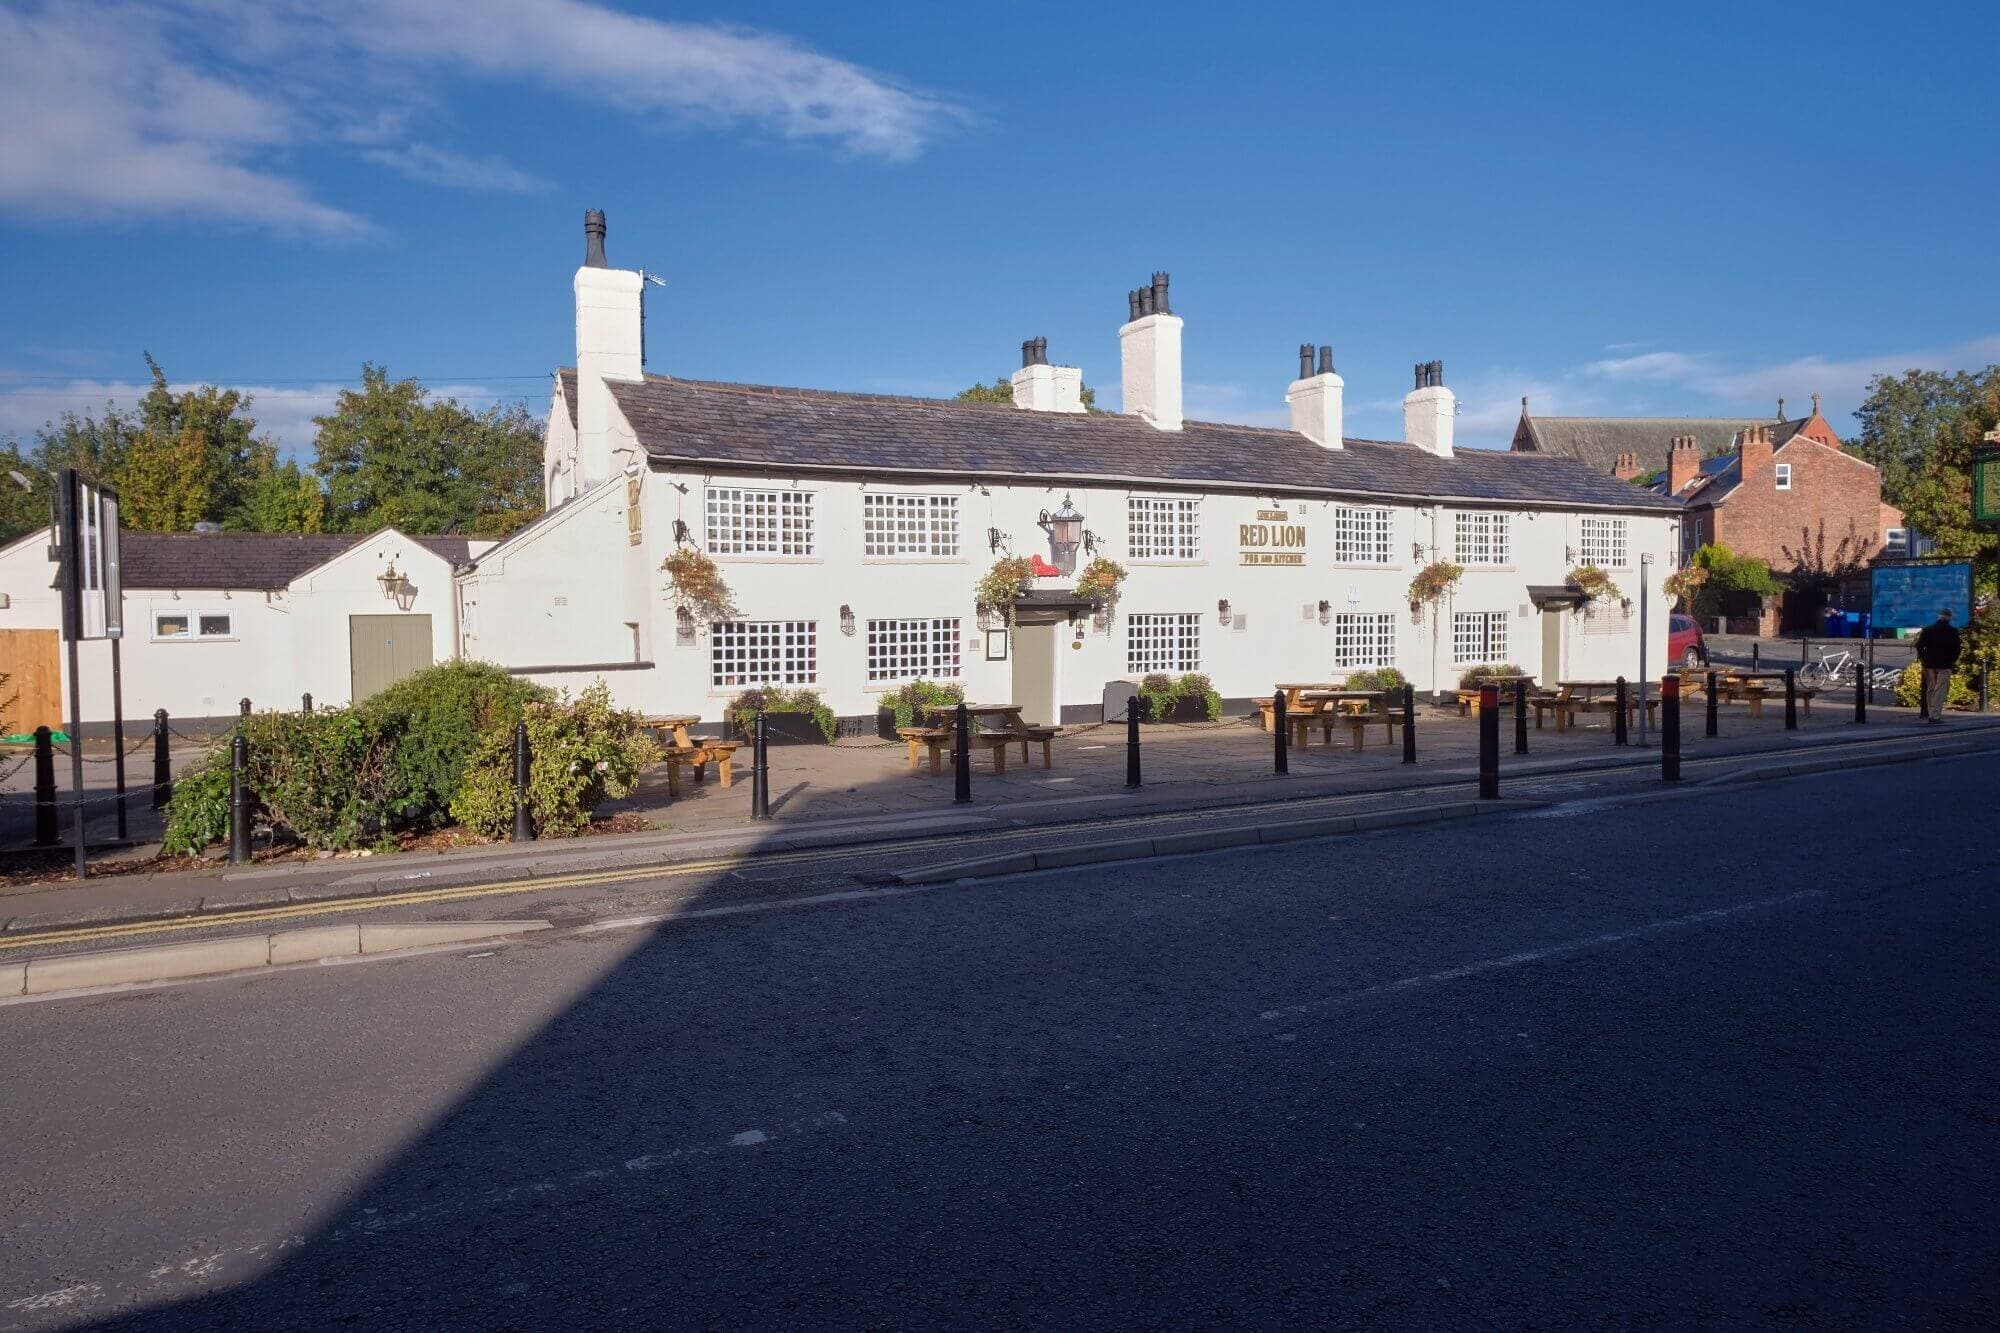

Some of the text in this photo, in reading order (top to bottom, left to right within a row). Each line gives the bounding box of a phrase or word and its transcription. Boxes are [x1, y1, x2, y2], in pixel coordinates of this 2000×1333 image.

[1240, 524, 1306, 548] RED LION
[1244, 554, 1259, 563] PUB
[1274, 554, 1303, 564] KITCHEN
